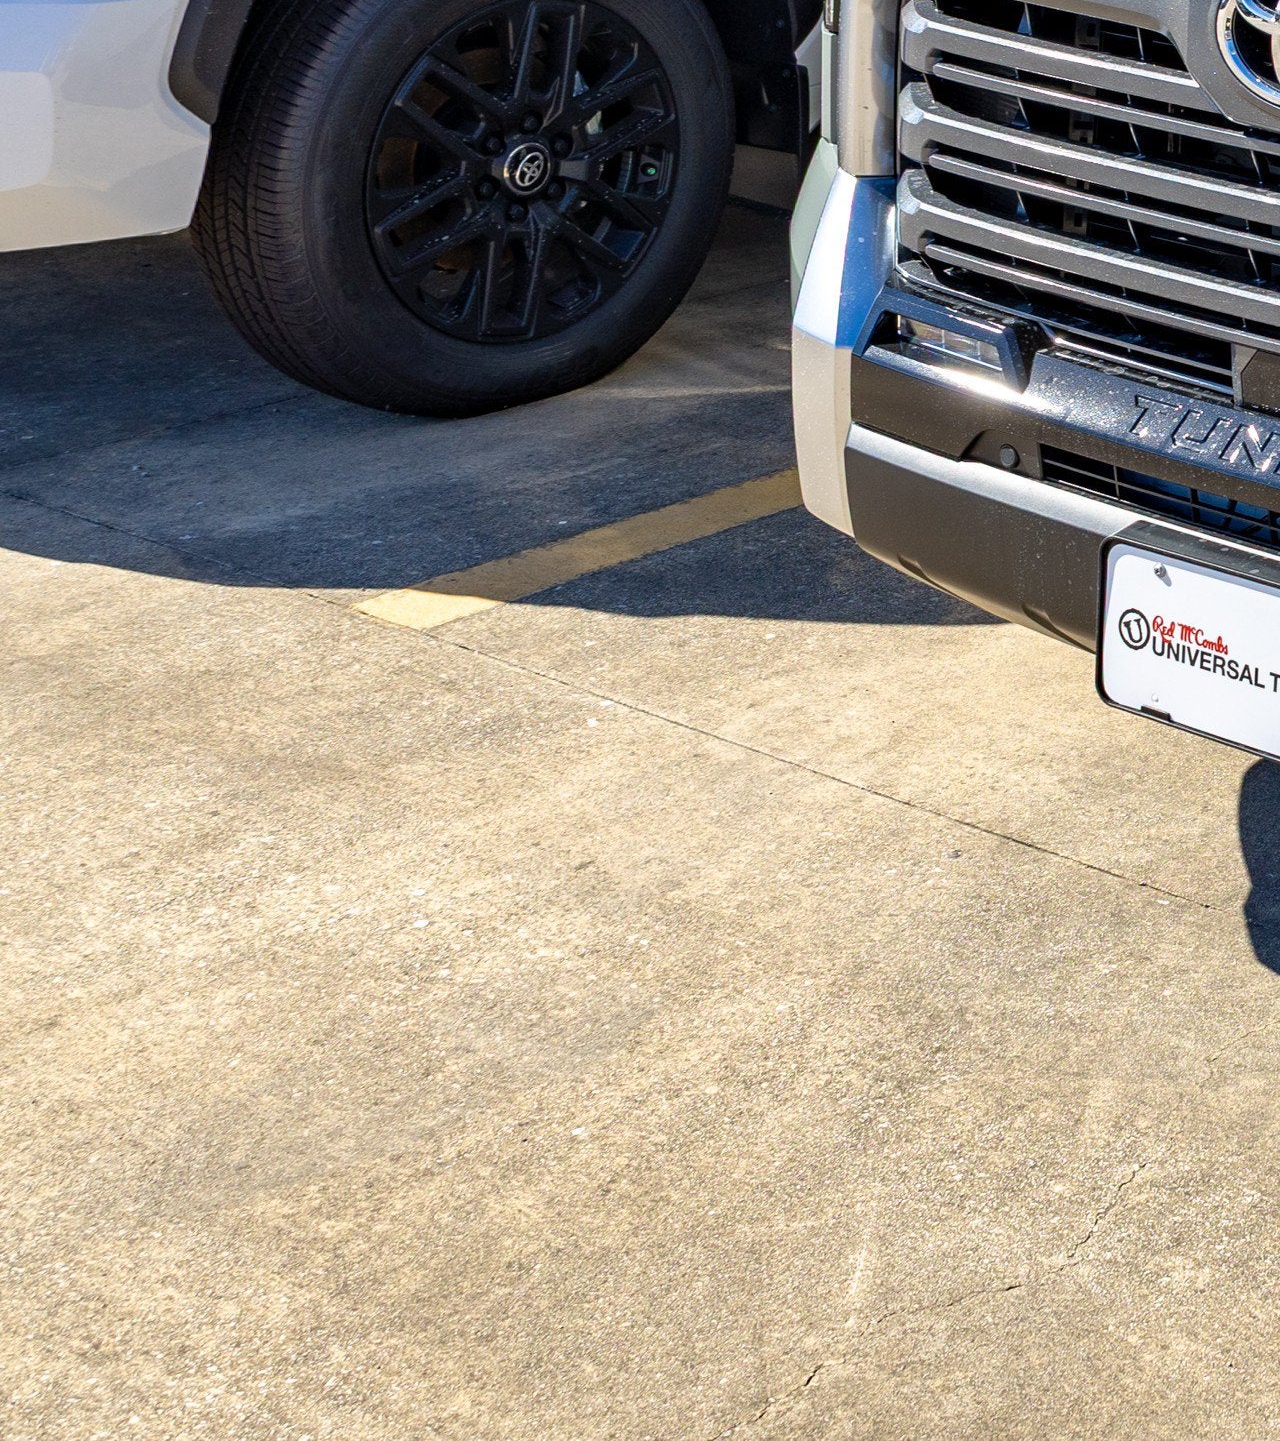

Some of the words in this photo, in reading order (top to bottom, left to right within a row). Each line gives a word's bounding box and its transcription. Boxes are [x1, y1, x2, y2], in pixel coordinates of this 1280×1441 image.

[1152, 615, 1176, 644] Red
[1177, 622, 1229, 655] McCombs
[1151, 635, 1266, 690] UNIVERSAL
